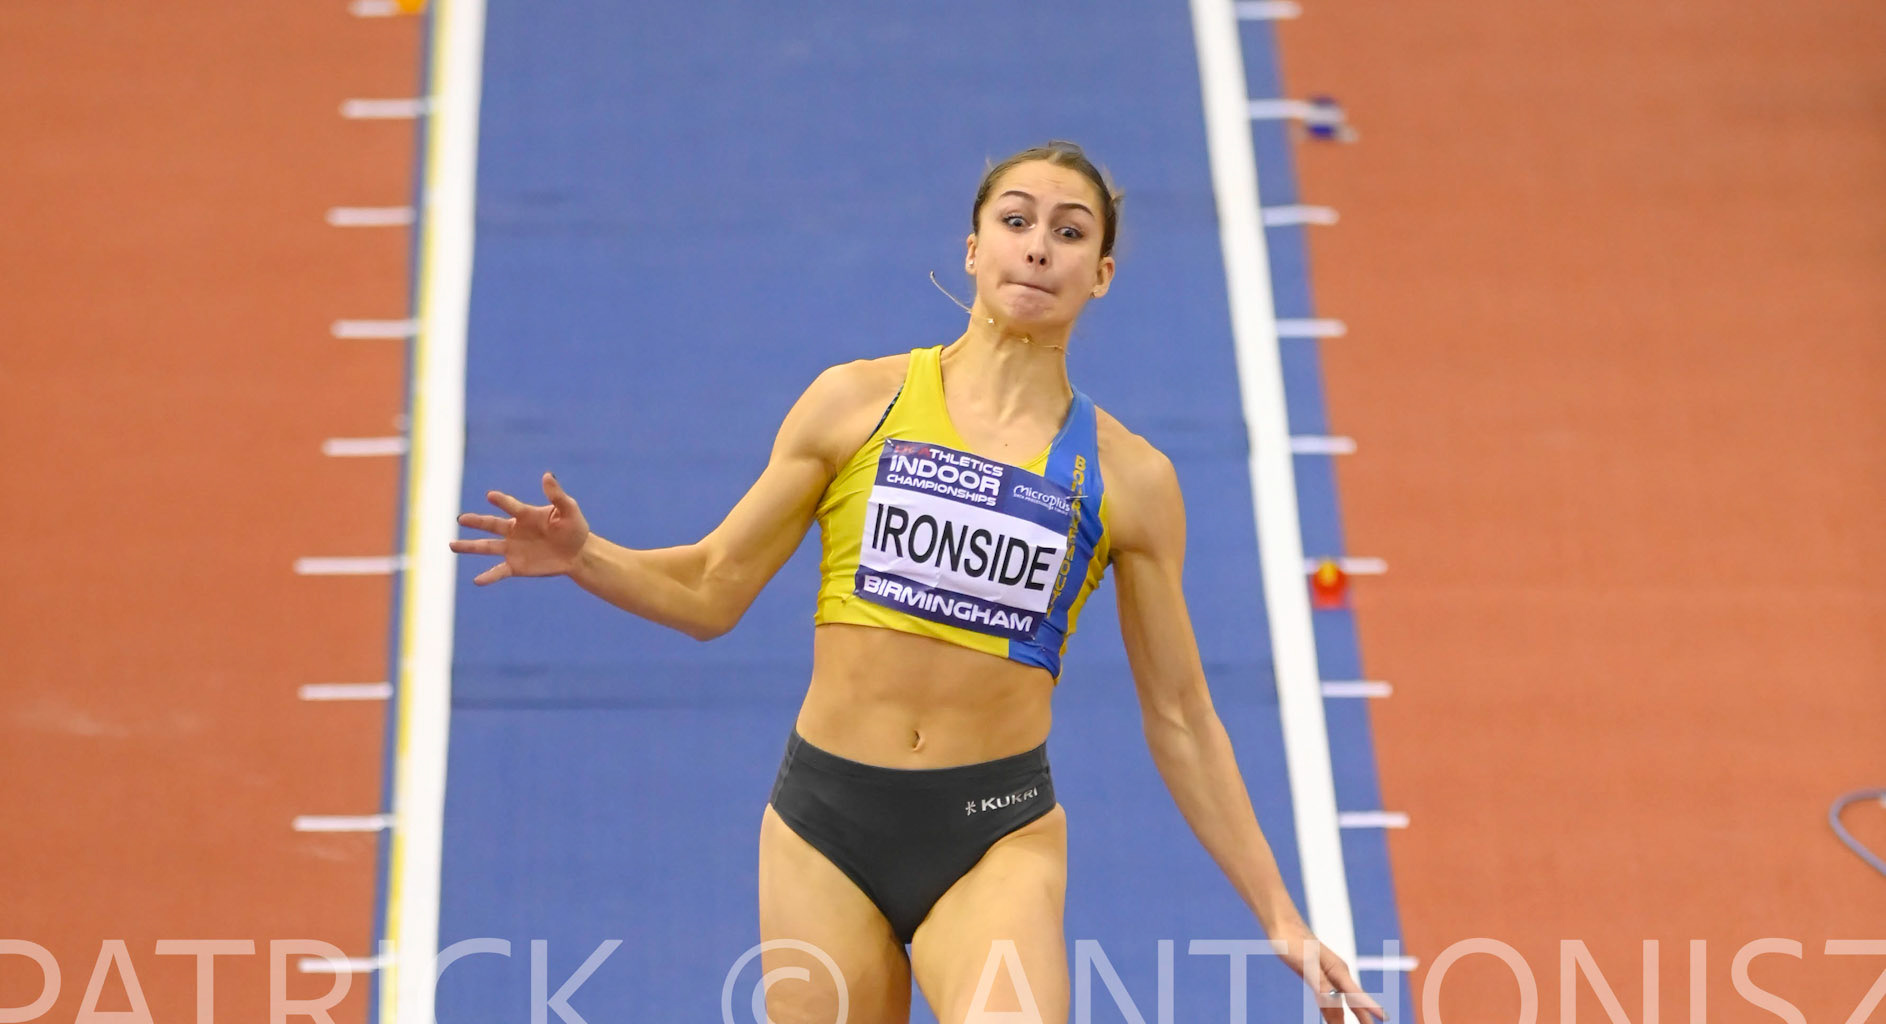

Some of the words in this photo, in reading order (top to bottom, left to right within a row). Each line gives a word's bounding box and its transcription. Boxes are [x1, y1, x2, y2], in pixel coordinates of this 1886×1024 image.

[889, 455, 1001, 496] INDOOR
[917, 447, 1004, 477] ATHLETICS
[886, 474, 997, 507] CHAMPIONSHIPS
[871, 503, 1057, 591] IRONSIDE
[863, 574, 1034, 633] BIRMINGHAM
[981, 786, 1038, 812] KUKRI
